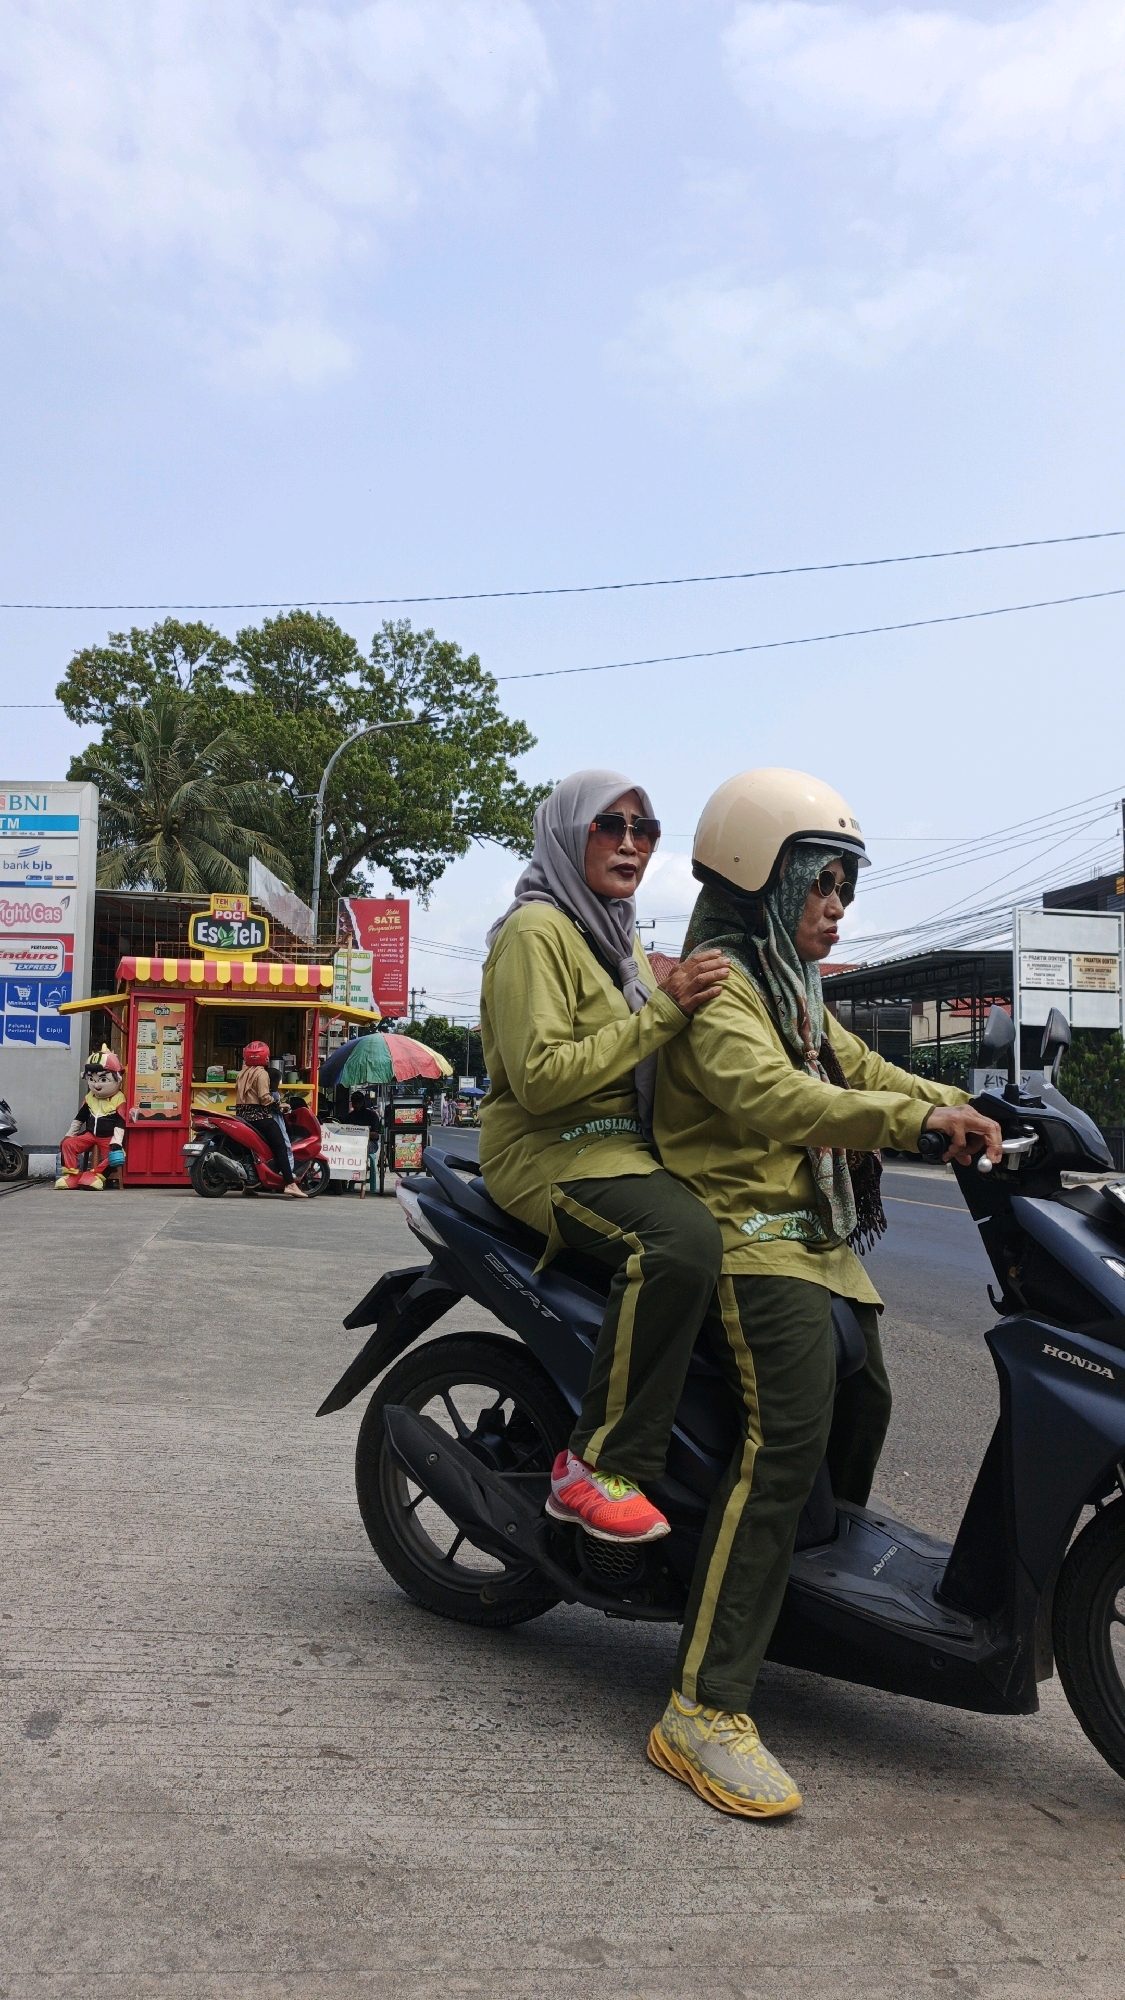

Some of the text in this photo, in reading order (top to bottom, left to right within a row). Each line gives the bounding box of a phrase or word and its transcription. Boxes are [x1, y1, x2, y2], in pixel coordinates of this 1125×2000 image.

[8, 794, 47, 811] BNI
[0, 817, 19, 830] TM
[3, 860, 52, 871] bank bjb
[0, 902, 62, 924] ight Gas
[215, 910, 246, 920] POCI
[374, 916, 401, 924] SATE
[197, 921, 262, 945] Es Teh
[340, 984, 361, 992] PLSTIK
[585, 1118, 641, 1134] MUSLIMA
[347, 1158, 362, 1166] OLI
[741, 1213, 768, 1237] PAC
[1042, 1343, 1115, 1380] HONDA
